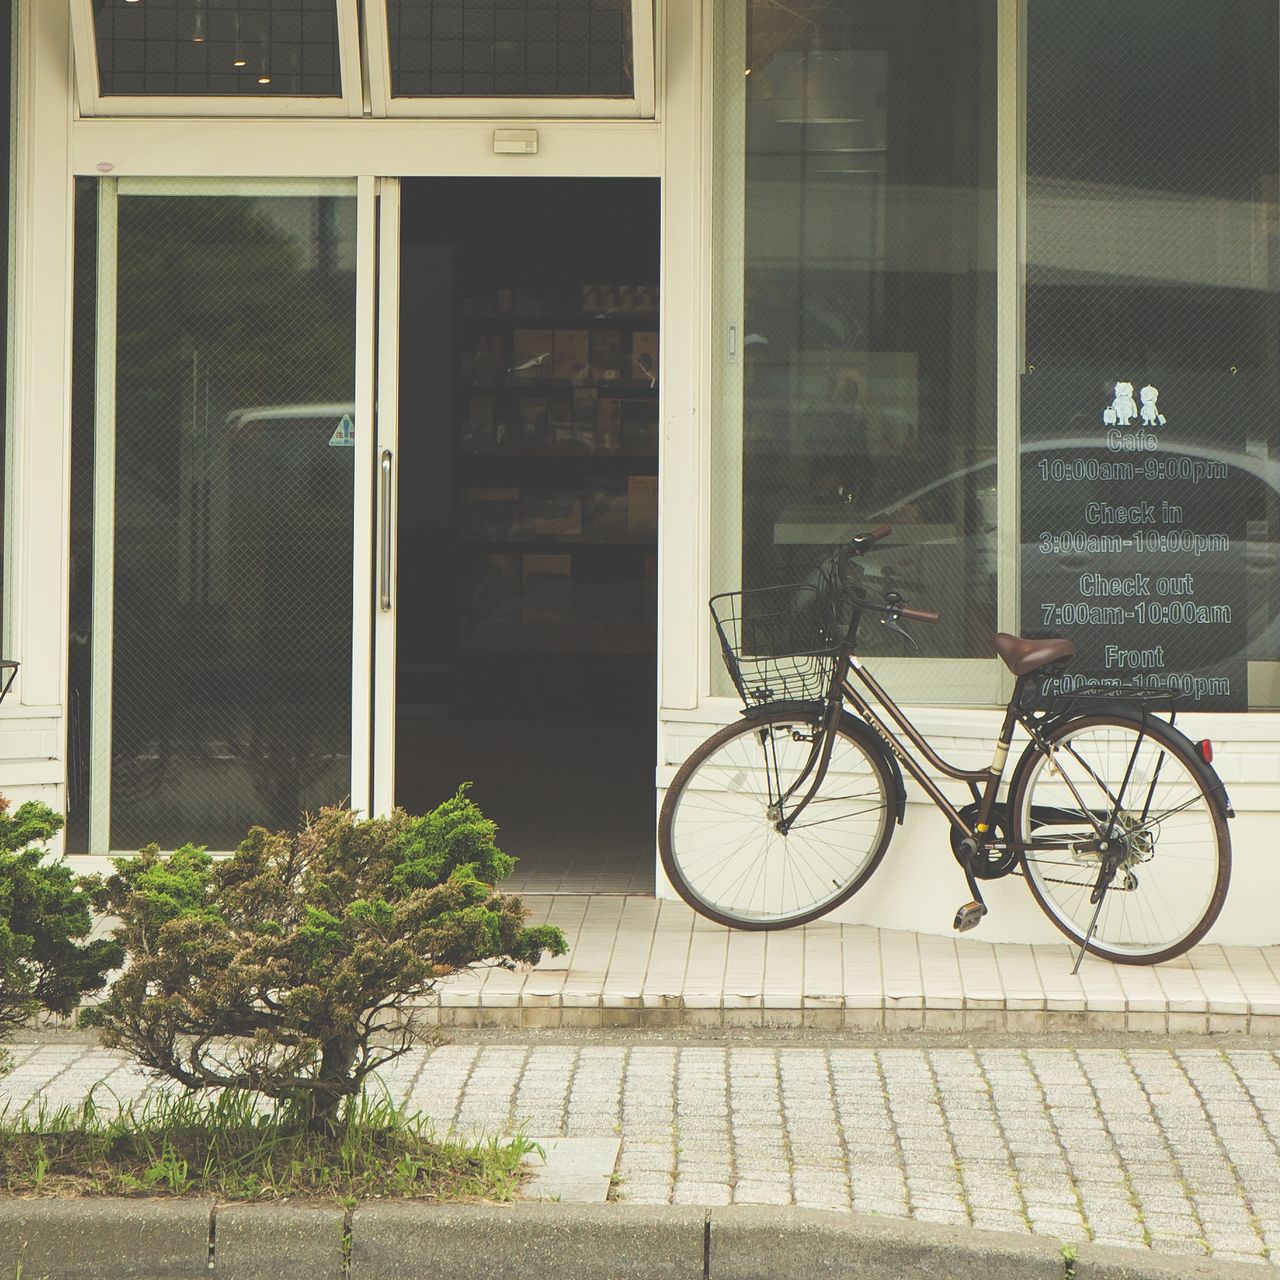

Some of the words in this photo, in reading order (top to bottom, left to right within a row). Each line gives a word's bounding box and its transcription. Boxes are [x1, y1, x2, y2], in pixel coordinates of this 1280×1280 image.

[1106, 428, 1159, 452] Cafe
[1038, 458, 1228, 483] 10:00am-9:00pm
[1085, 501, 1156, 524] Check
[1162, 501, 1183, 524] in
[1039, 530, 1230, 556] 3:00am-10:00pm
[1079, 573, 1150, 596] Check
[1156, 573, 1194, 596] out
[1041, 601, 1232, 625] 7:00am-10:00am
[1104, 645, 1165, 669] Front
